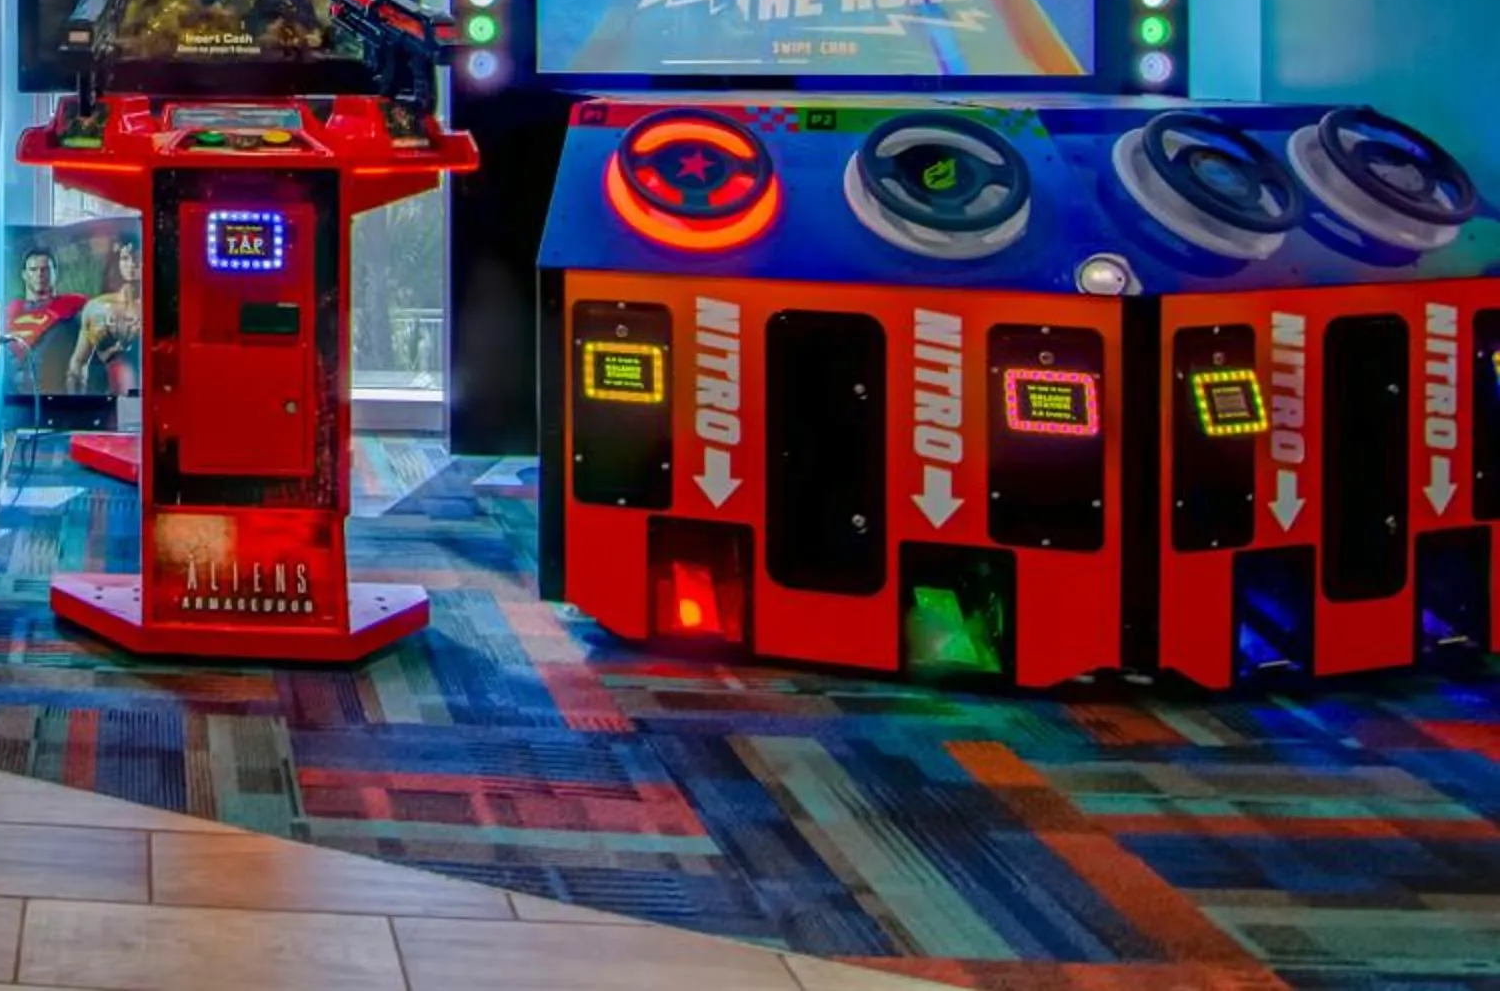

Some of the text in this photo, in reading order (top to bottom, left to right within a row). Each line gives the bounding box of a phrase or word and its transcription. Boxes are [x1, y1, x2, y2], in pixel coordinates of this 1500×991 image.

[811, 114, 833, 126] P2
[226, 235, 264, 251] TAP
[695, 296, 741, 446] NITRO
[913, 308, 963, 464] NITRO
[1271, 311, 1306, 464] NITRO
[1426, 302, 1459, 450] NITRO
[181, 596, 314, 614] ARMAGEDDON
[187, 561, 307, 592] ALIENS
